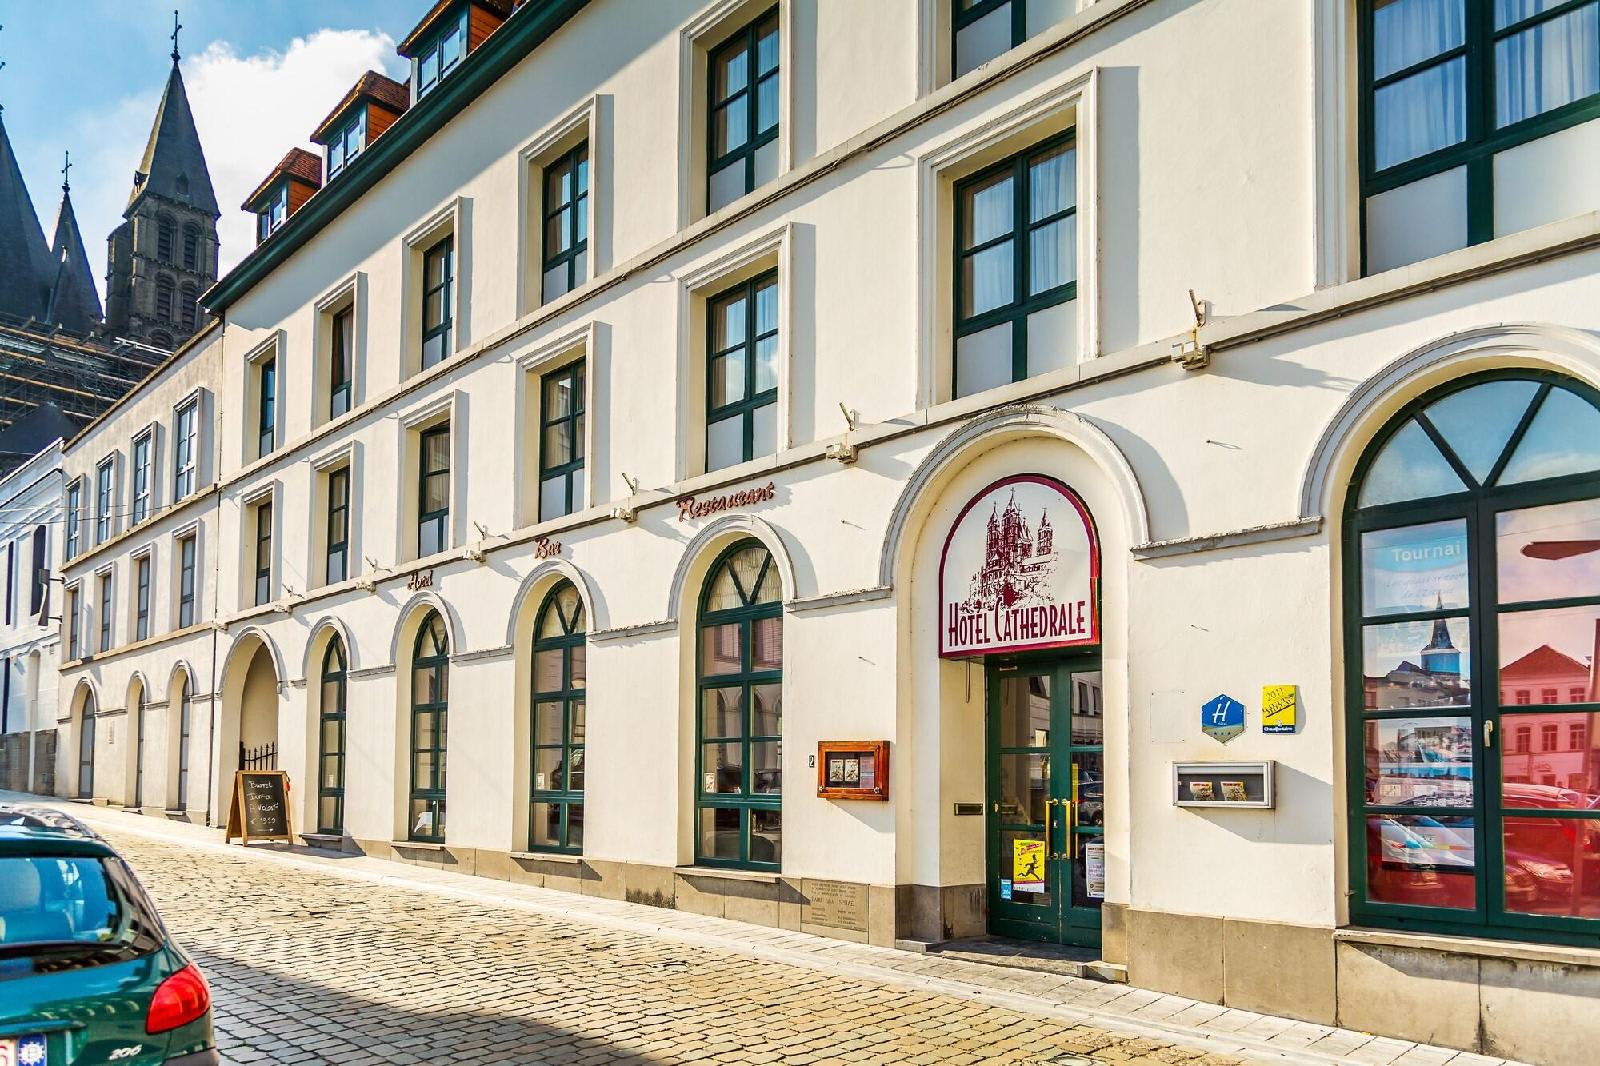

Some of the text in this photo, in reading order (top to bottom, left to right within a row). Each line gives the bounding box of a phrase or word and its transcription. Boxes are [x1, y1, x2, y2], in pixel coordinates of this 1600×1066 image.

[676, 482, 775, 522] Restaurant
[534, 537, 562, 559] Bar
[1391, 540, 1461, 562] Tournai
[994, 596, 1086, 642] CATHEDRALE
[108, 1044, 143, 1060] 206
